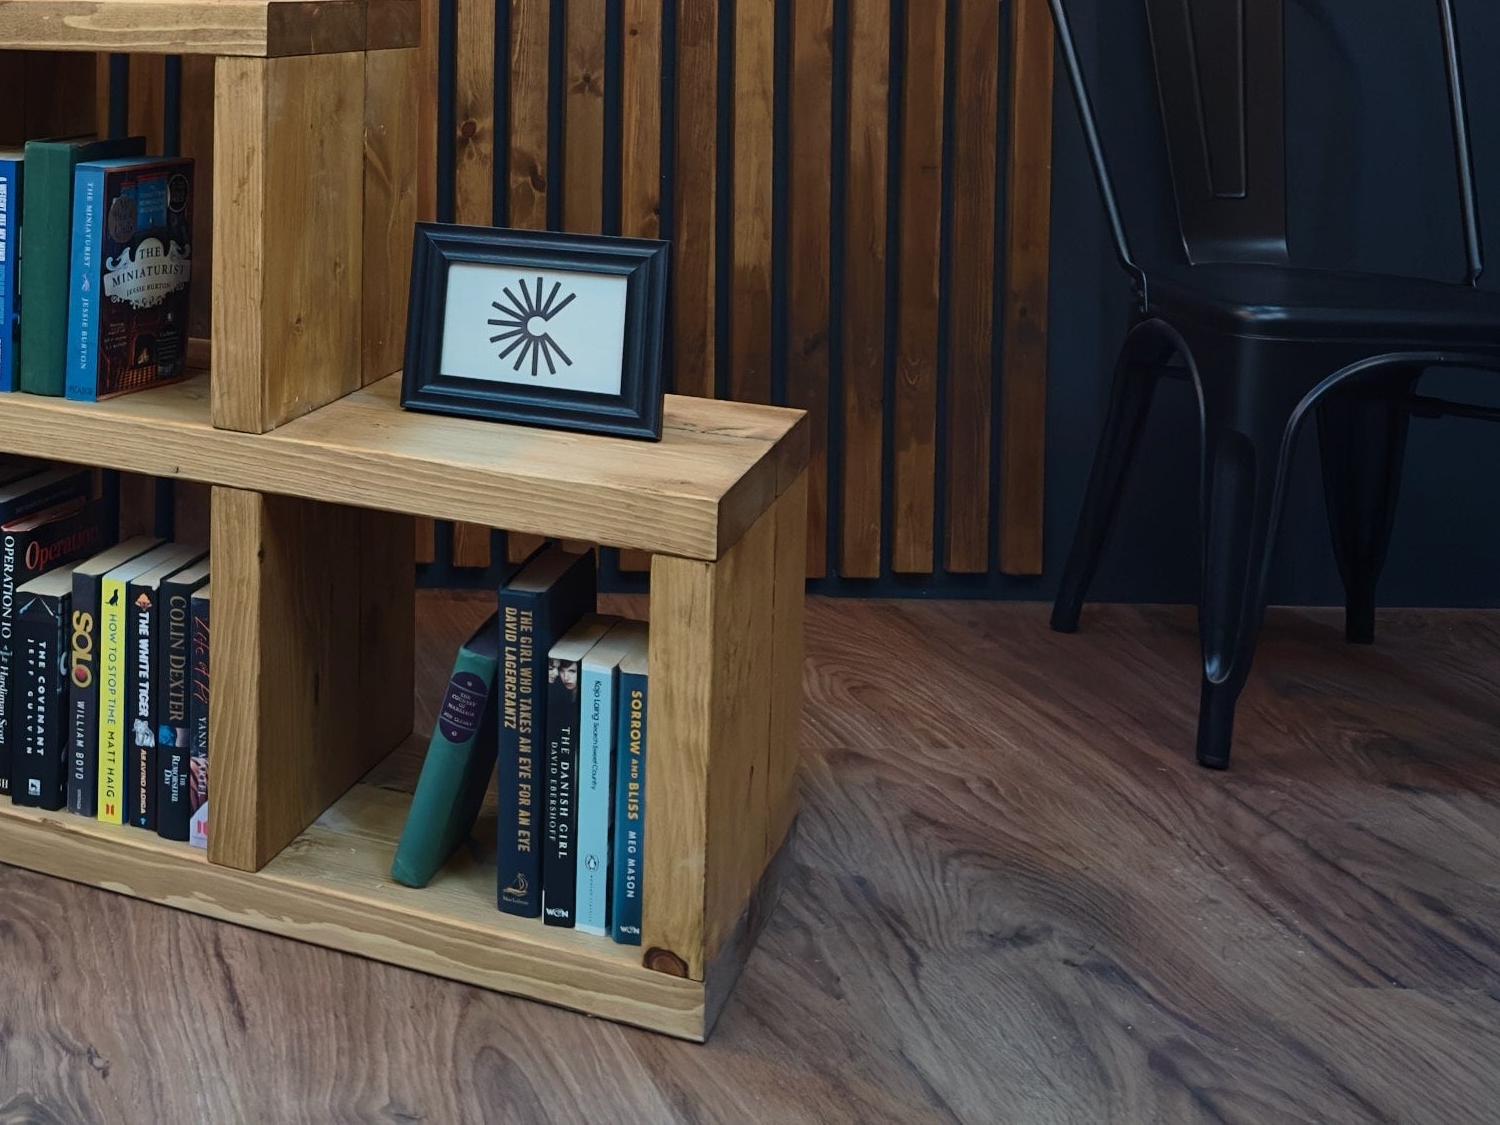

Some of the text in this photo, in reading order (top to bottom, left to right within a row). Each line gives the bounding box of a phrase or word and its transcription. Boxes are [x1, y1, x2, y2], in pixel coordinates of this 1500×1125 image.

[84, 182, 94, 267] THE MINIATURIST
[138, 246, 162, 259] THE
[112, 266, 184, 287] MINIATURIST
[80, 297, 90, 370] JESSIE BURTON
[71, 610, 94, 687] SOLO
[107, 613, 118, 724] HOW TO STOP TIME
[138, 611, 150, 717] THE WHITE TIGER
[169, 595, 186, 721] COLIN DEXTER
[504, 606, 517, 730] DAVID LAGERCRANTZ
[26, 691, 34, 755] GULVIN
[36, 641, 46, 756] THE COVENANT
[198, 715, 208, 747] YANN
[518, 611, 532, 852] THE GIRL WHO TAKES AN EYE FOR AN EYE
[592, 680, 602, 721] Kojo Laing
[75, 700, 86, 780] WILLIAM BOYD
[106, 731, 116, 798] MATT HAIG
[171, 755, 180, 803] REMORSEFUL
[627, 689, 642, 821] SORROW AND BLISS
[140, 749, 148, 814] ARAVIND ADIGA
[549, 741, 558, 842] DAVID EBERSHOFF
[558, 726, 571, 860] THE DANISH GIRL
[626, 831, 638, 898] MEG MASON
